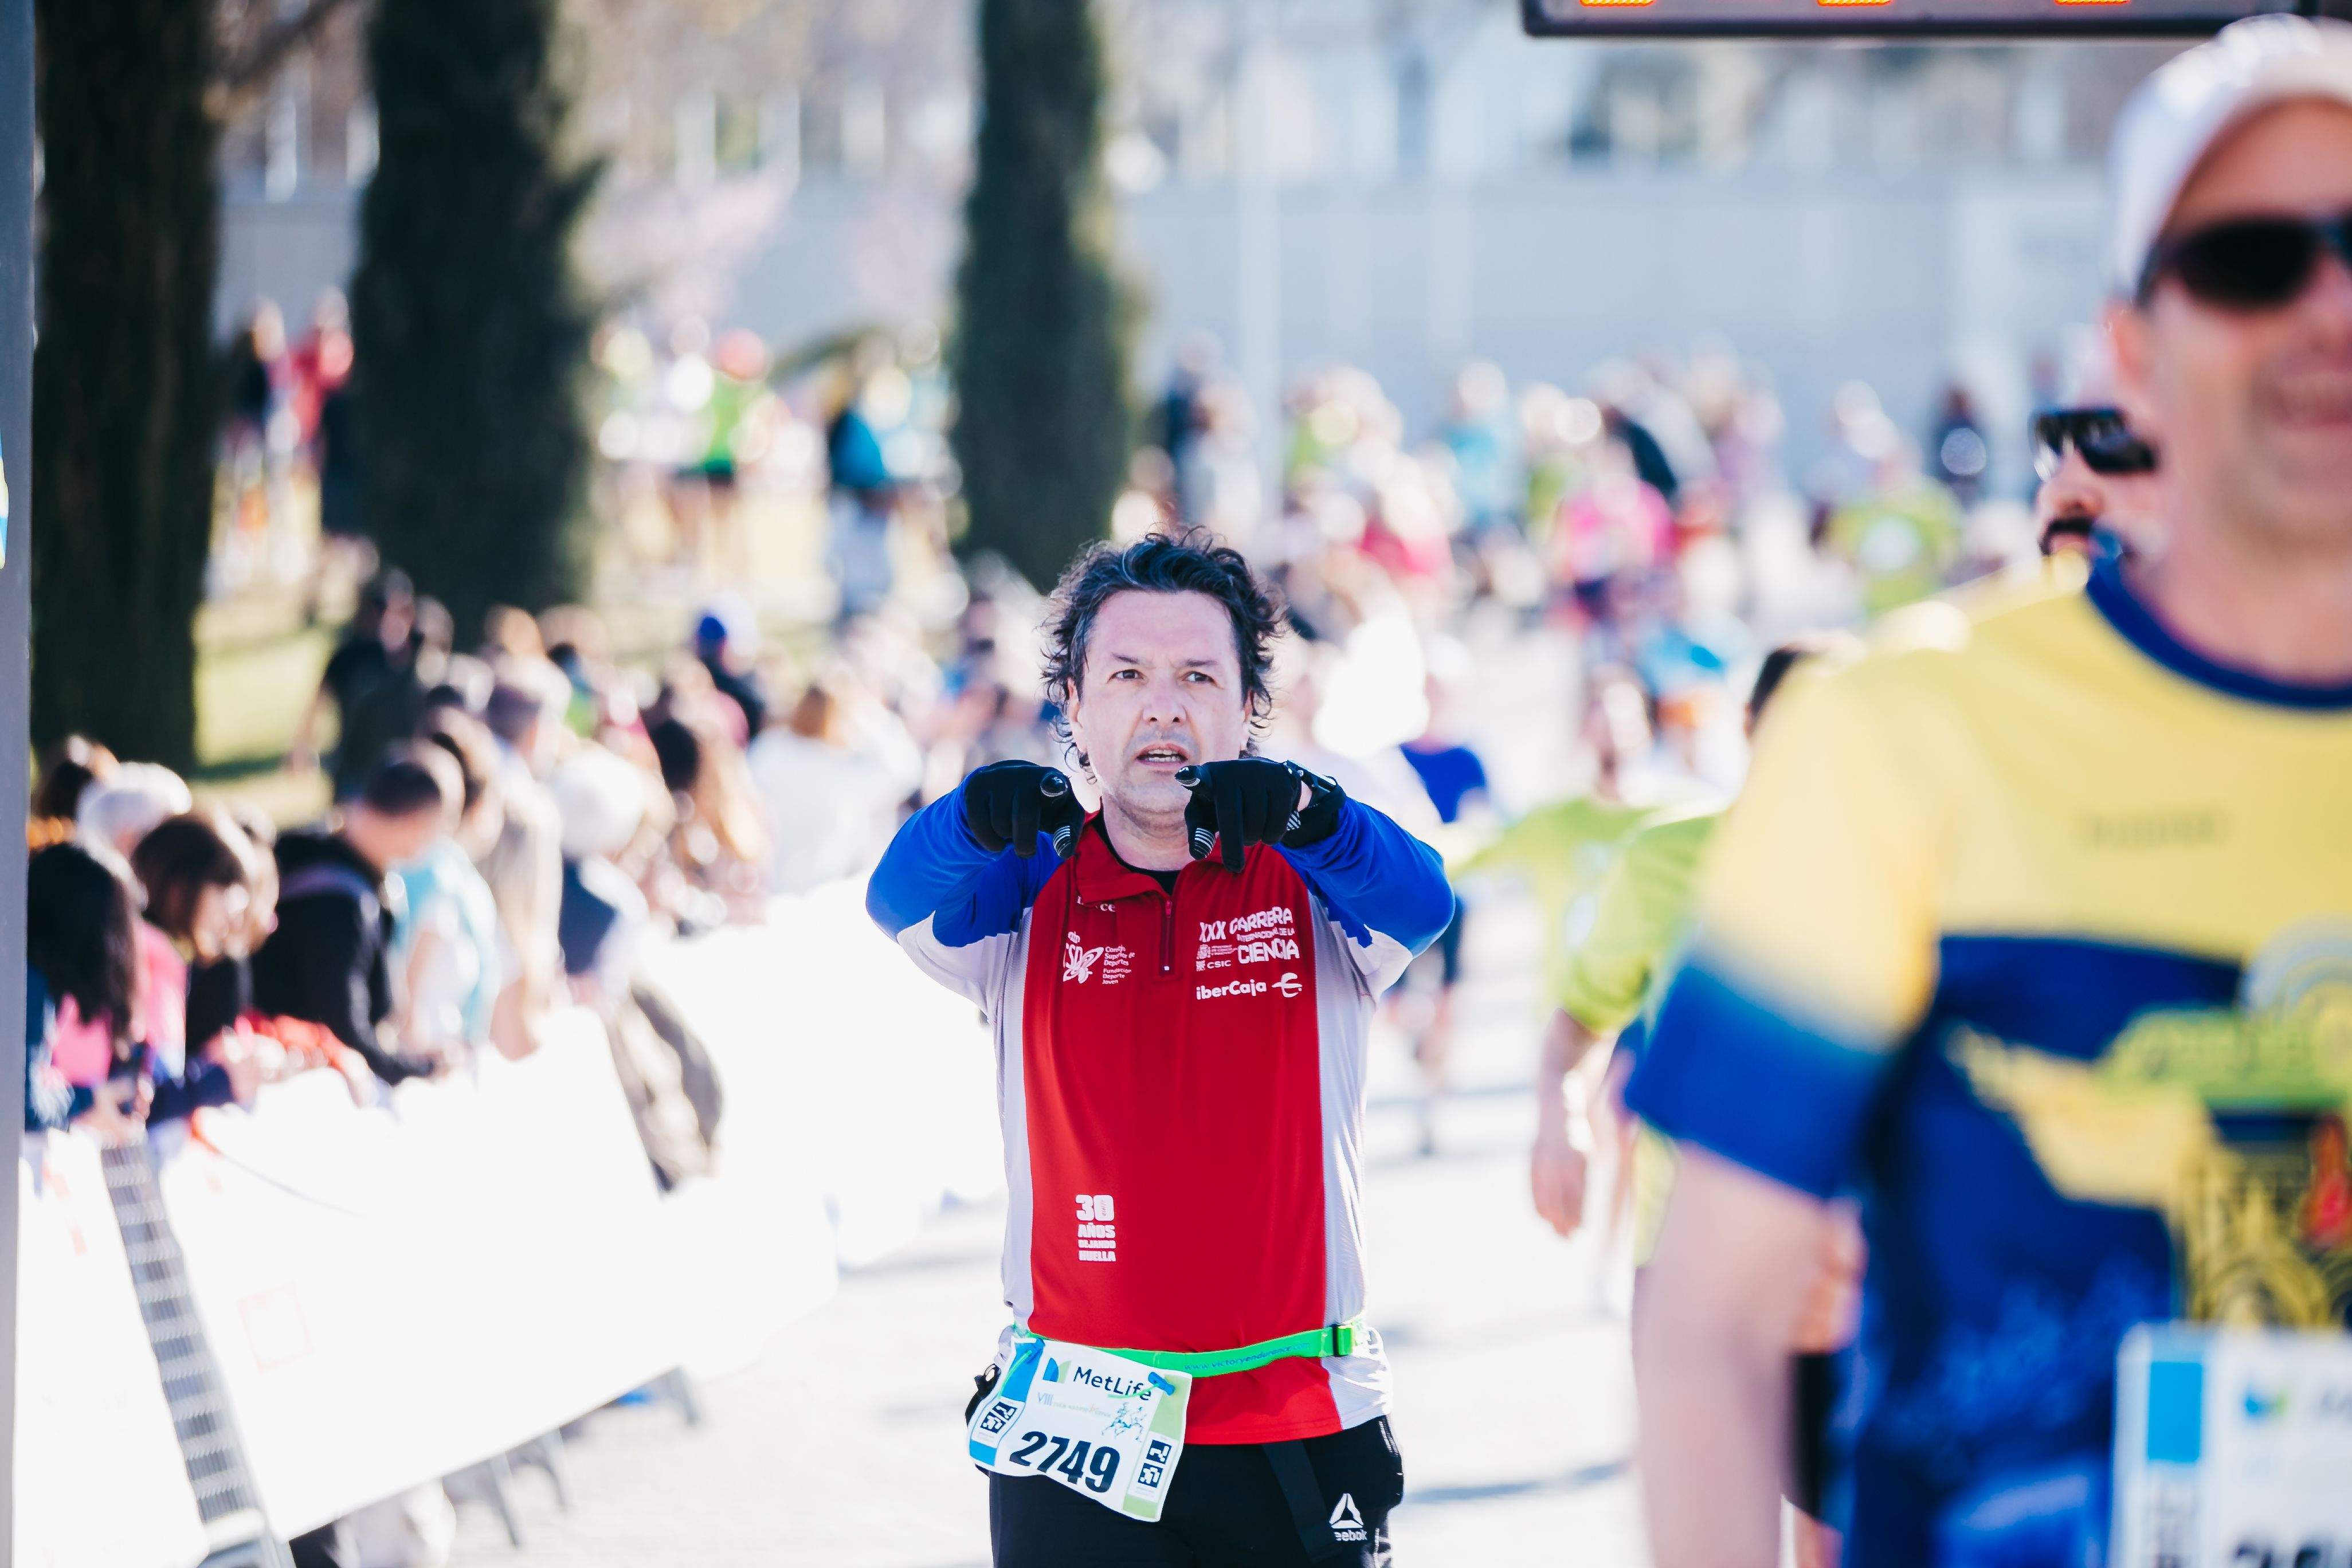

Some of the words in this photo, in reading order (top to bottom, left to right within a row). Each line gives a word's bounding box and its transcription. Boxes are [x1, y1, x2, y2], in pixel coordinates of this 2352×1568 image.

[1199, 920, 1226, 943] XXX
[1229, 906, 1293, 934] CARRERA
[1104, 959, 1129, 967] Deportes
[1237, 938, 1300, 964] CIENCIA
[1206, 960, 1232, 969] CSIC
[1075, 1194, 1115, 1221] 30
[1077, 1222, 1116, 1238] AÑOS
[1073, 1366, 1152, 1402] MetLife
[1009, 1430, 1121, 1493] 2749
